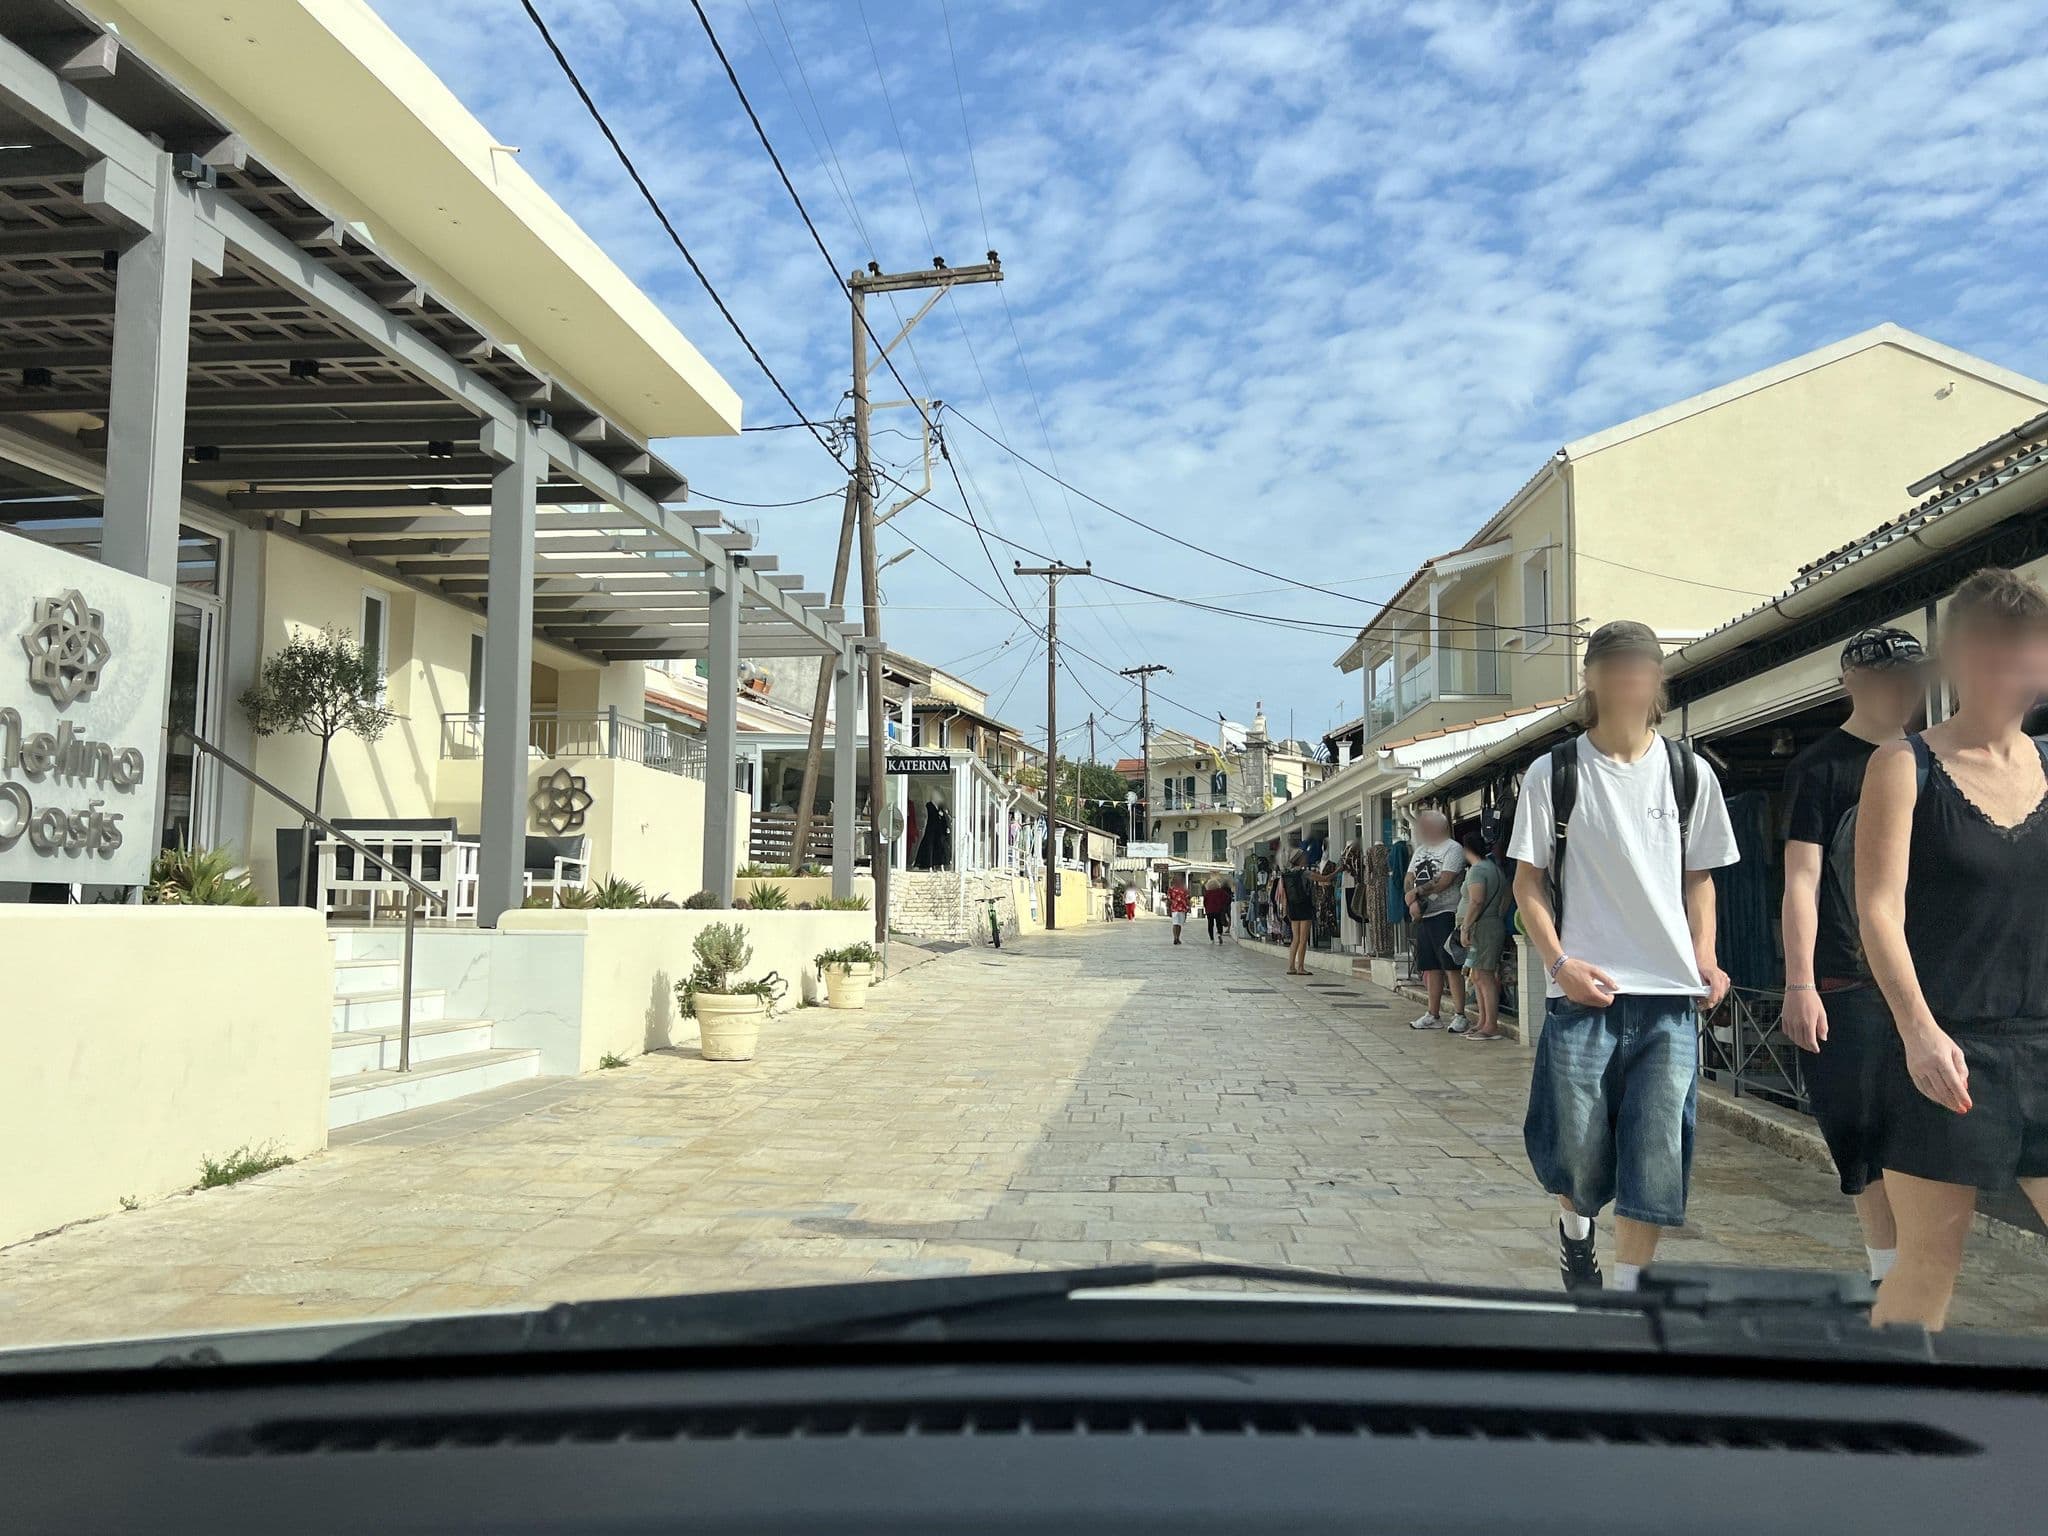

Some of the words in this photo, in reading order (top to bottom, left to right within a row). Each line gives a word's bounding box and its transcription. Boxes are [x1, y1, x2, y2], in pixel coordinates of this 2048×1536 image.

[888, 760, 948, 771] KATERINA
[0, 781, 124, 850] Oasis
[1647, 807, 1676, 820] POL
